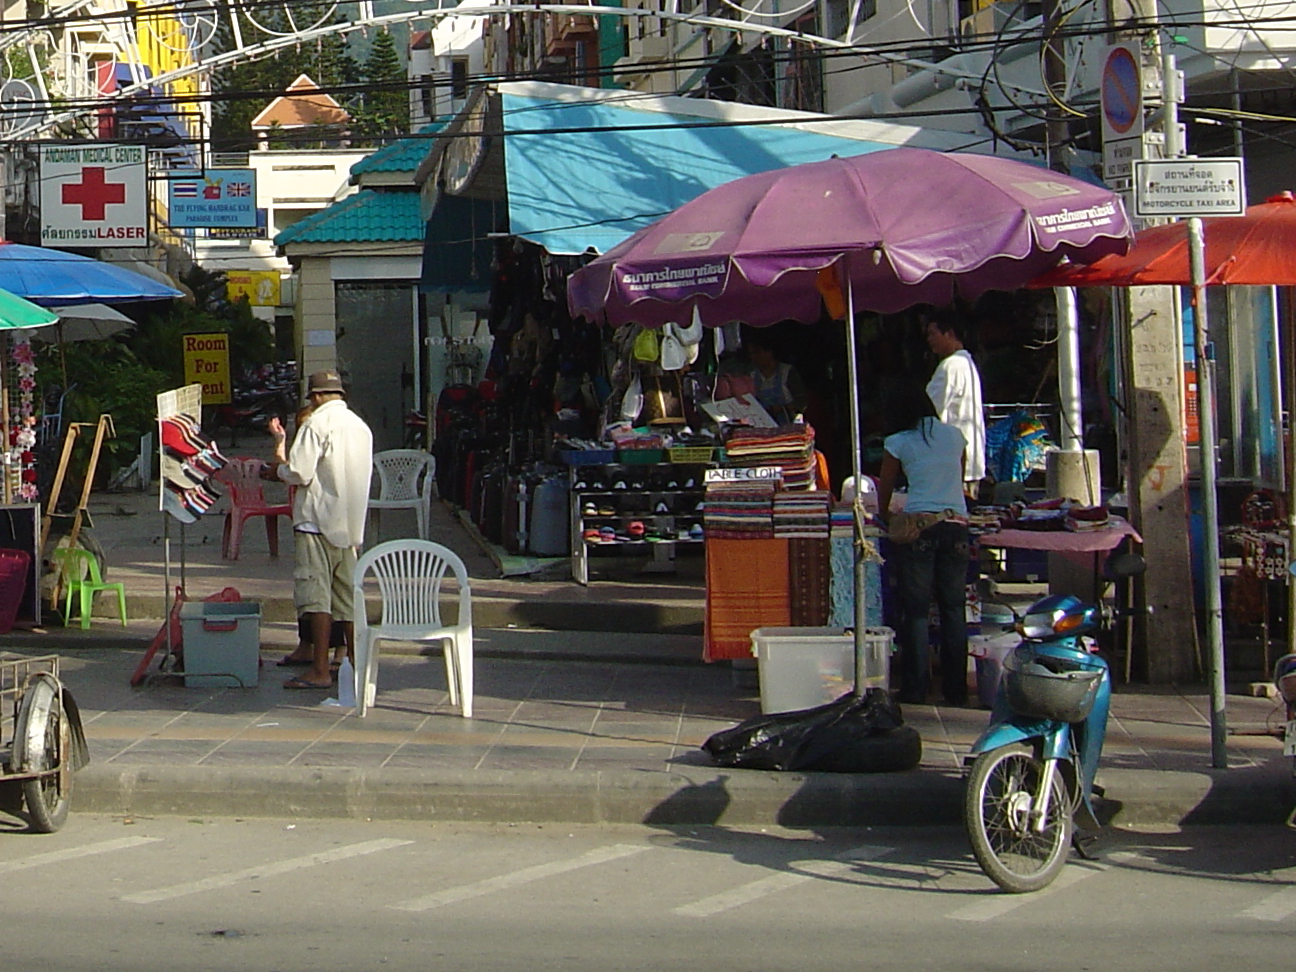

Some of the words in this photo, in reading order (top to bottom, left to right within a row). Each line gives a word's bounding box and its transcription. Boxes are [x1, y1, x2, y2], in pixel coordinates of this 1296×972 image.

[83, 148, 113, 163] MEDICAL
[115, 148, 142, 163] CENTER
[1142, 200, 1194, 208] MOTORCYCLE
[1197, 199, 1213, 207] TAXI
[1215, 199, 1236, 207] AREA
[97, 227, 146, 239] LASER
[185, 337, 227, 352] Room
[195, 358, 219, 374] For
[201, 381, 225, 396] ent
[708, 468, 741, 479] TABLE
[745, 467, 782, 479] CLOTH
